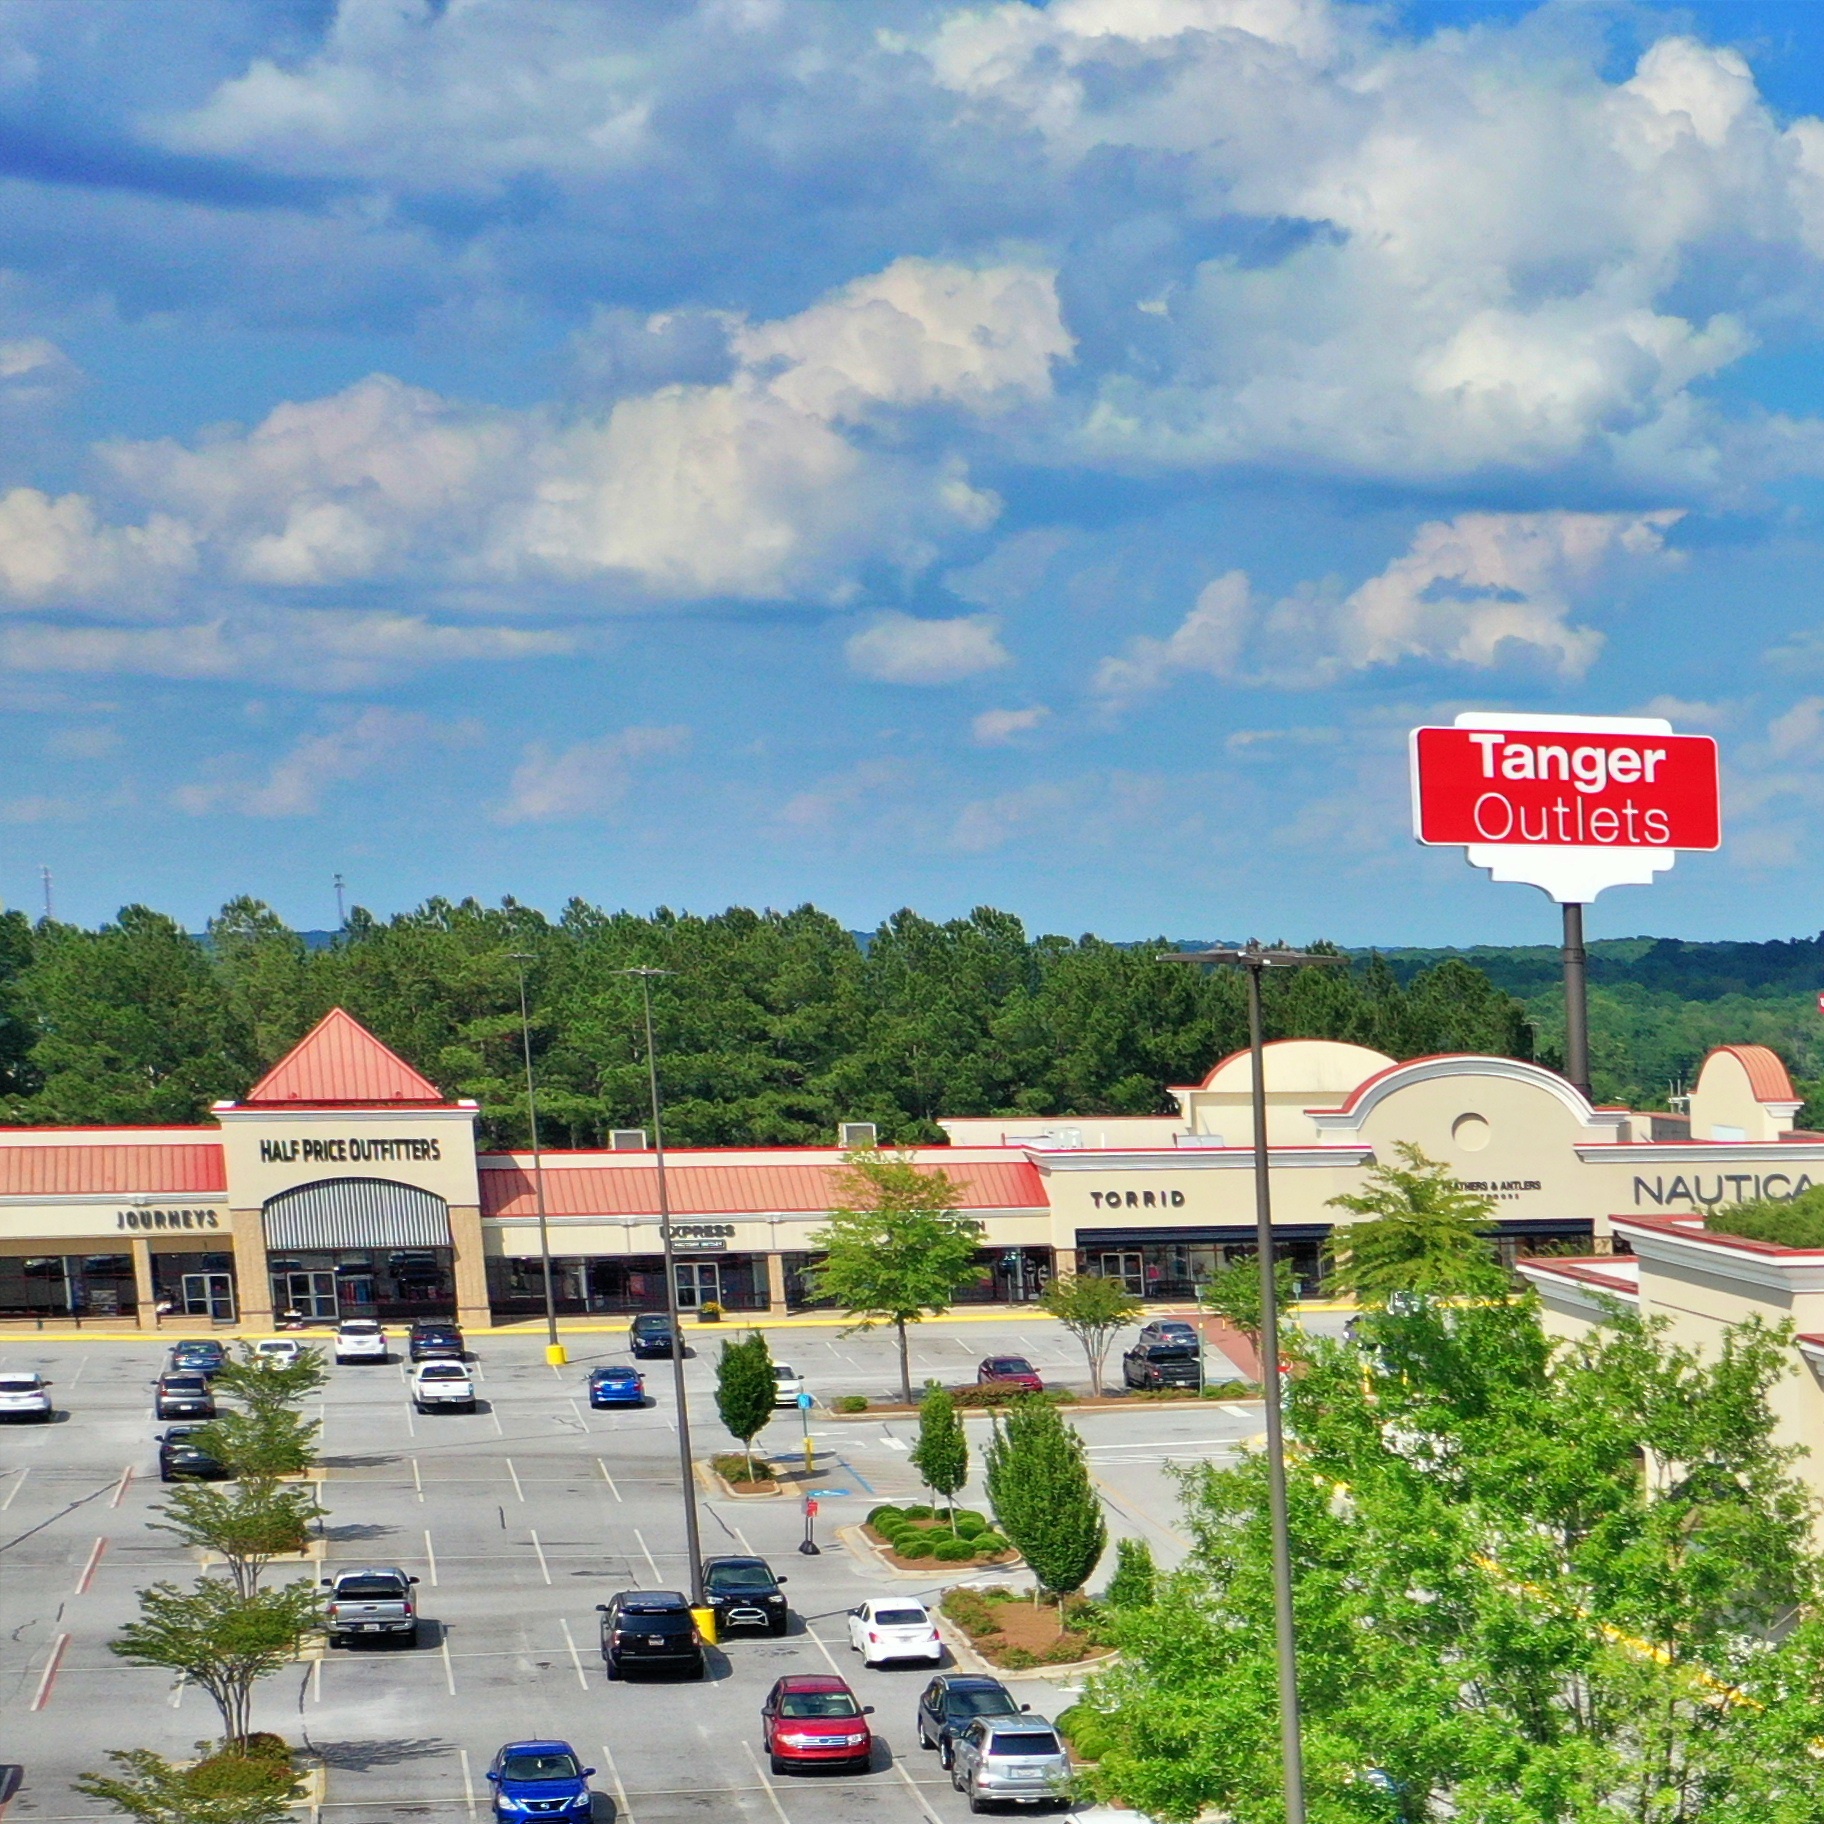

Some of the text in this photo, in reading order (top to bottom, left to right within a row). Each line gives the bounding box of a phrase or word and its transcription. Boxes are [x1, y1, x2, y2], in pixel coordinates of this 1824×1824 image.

[1469, 733, 1667, 794] Tanger
[1473, 791, 1671, 844] Outlets
[260, 1138, 442, 1163] HALF PRICE OUTFITTERS
[1500, 1180, 1542, 1191] ANTLERS
[1633, 1173, 1814, 1206] NAUTICA
[1090, 1190, 1186, 1209] TORRID
[117, 1209, 219, 1231] JOURNEYS
